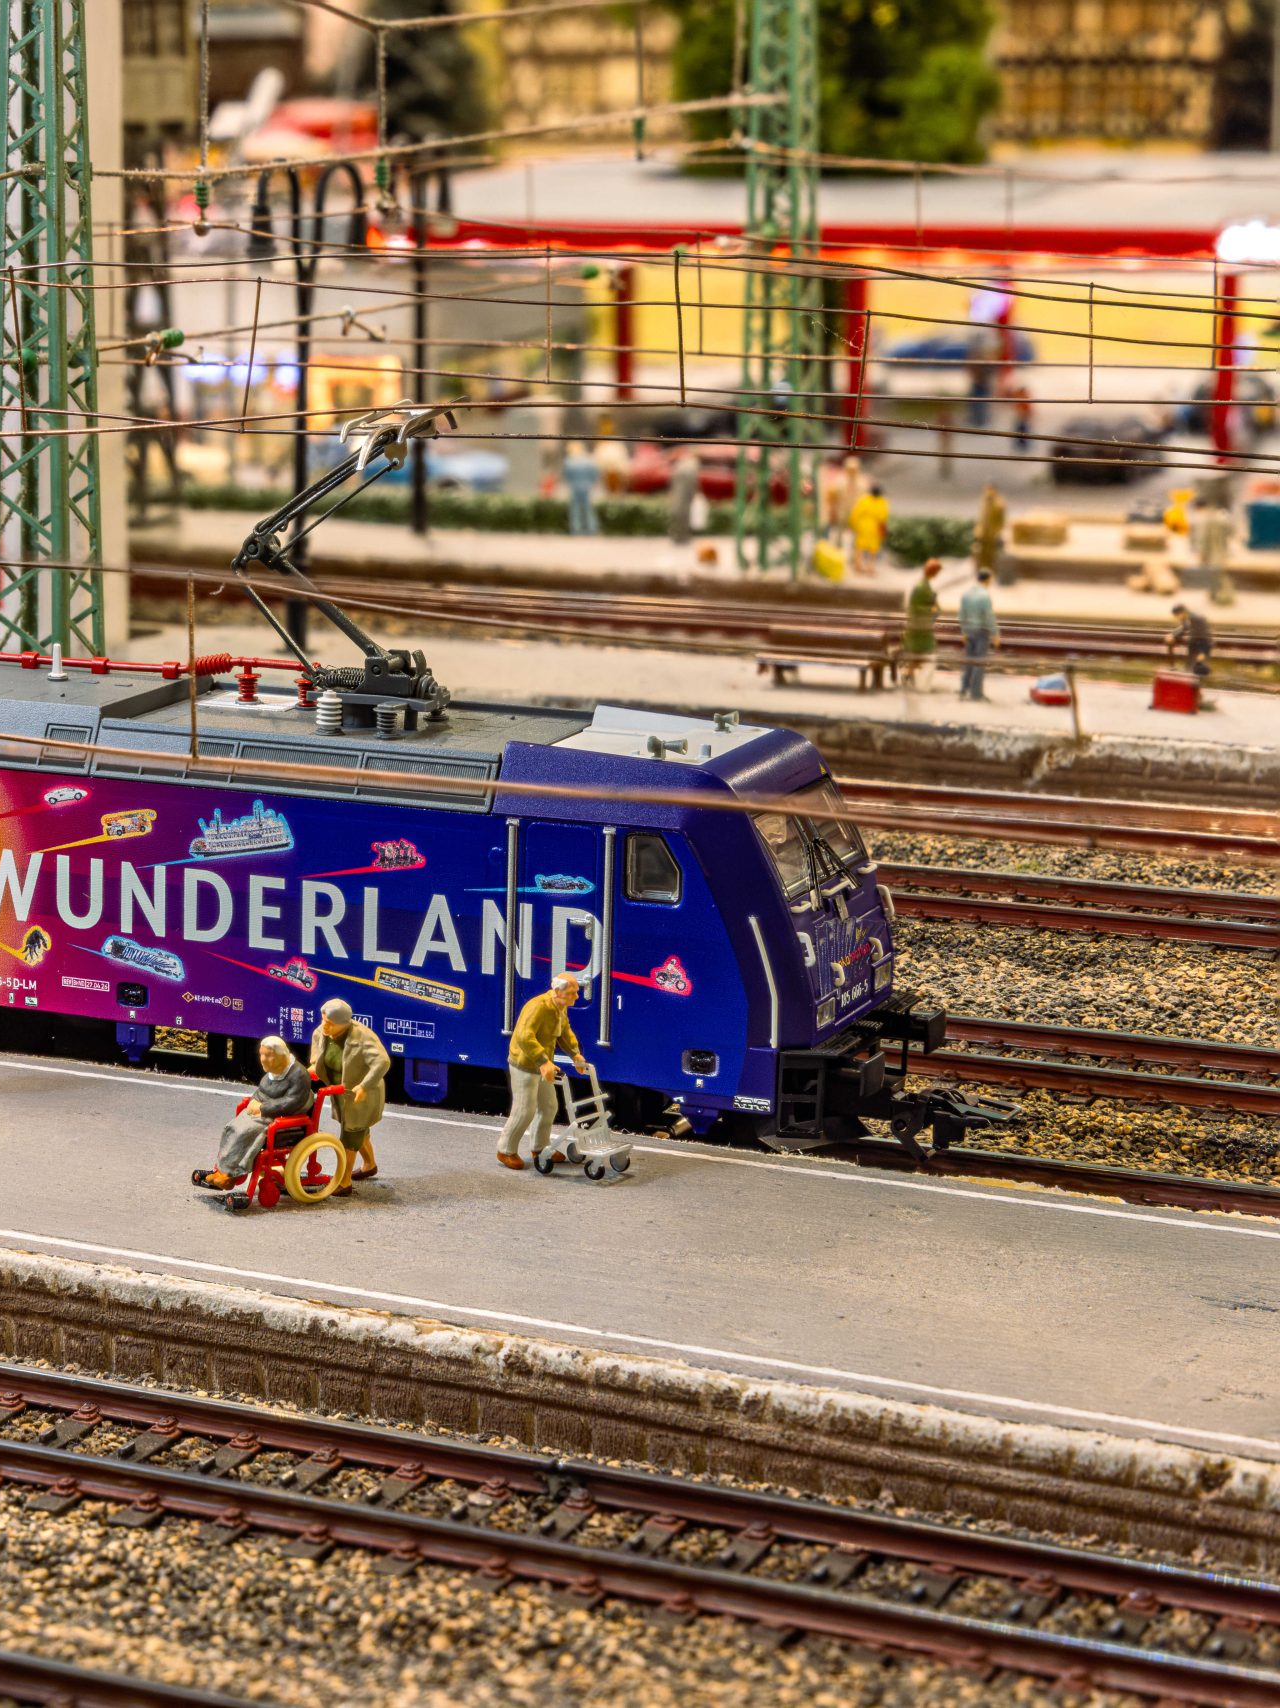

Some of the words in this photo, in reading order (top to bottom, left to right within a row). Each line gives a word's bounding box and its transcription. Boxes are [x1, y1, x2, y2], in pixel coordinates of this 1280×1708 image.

[13, 977, 37, 991] D-LM
[841, 989, 851, 1008] 185
[851, 978, 869, 1001] 666-5
[616, 995, 622, 1010] 1
